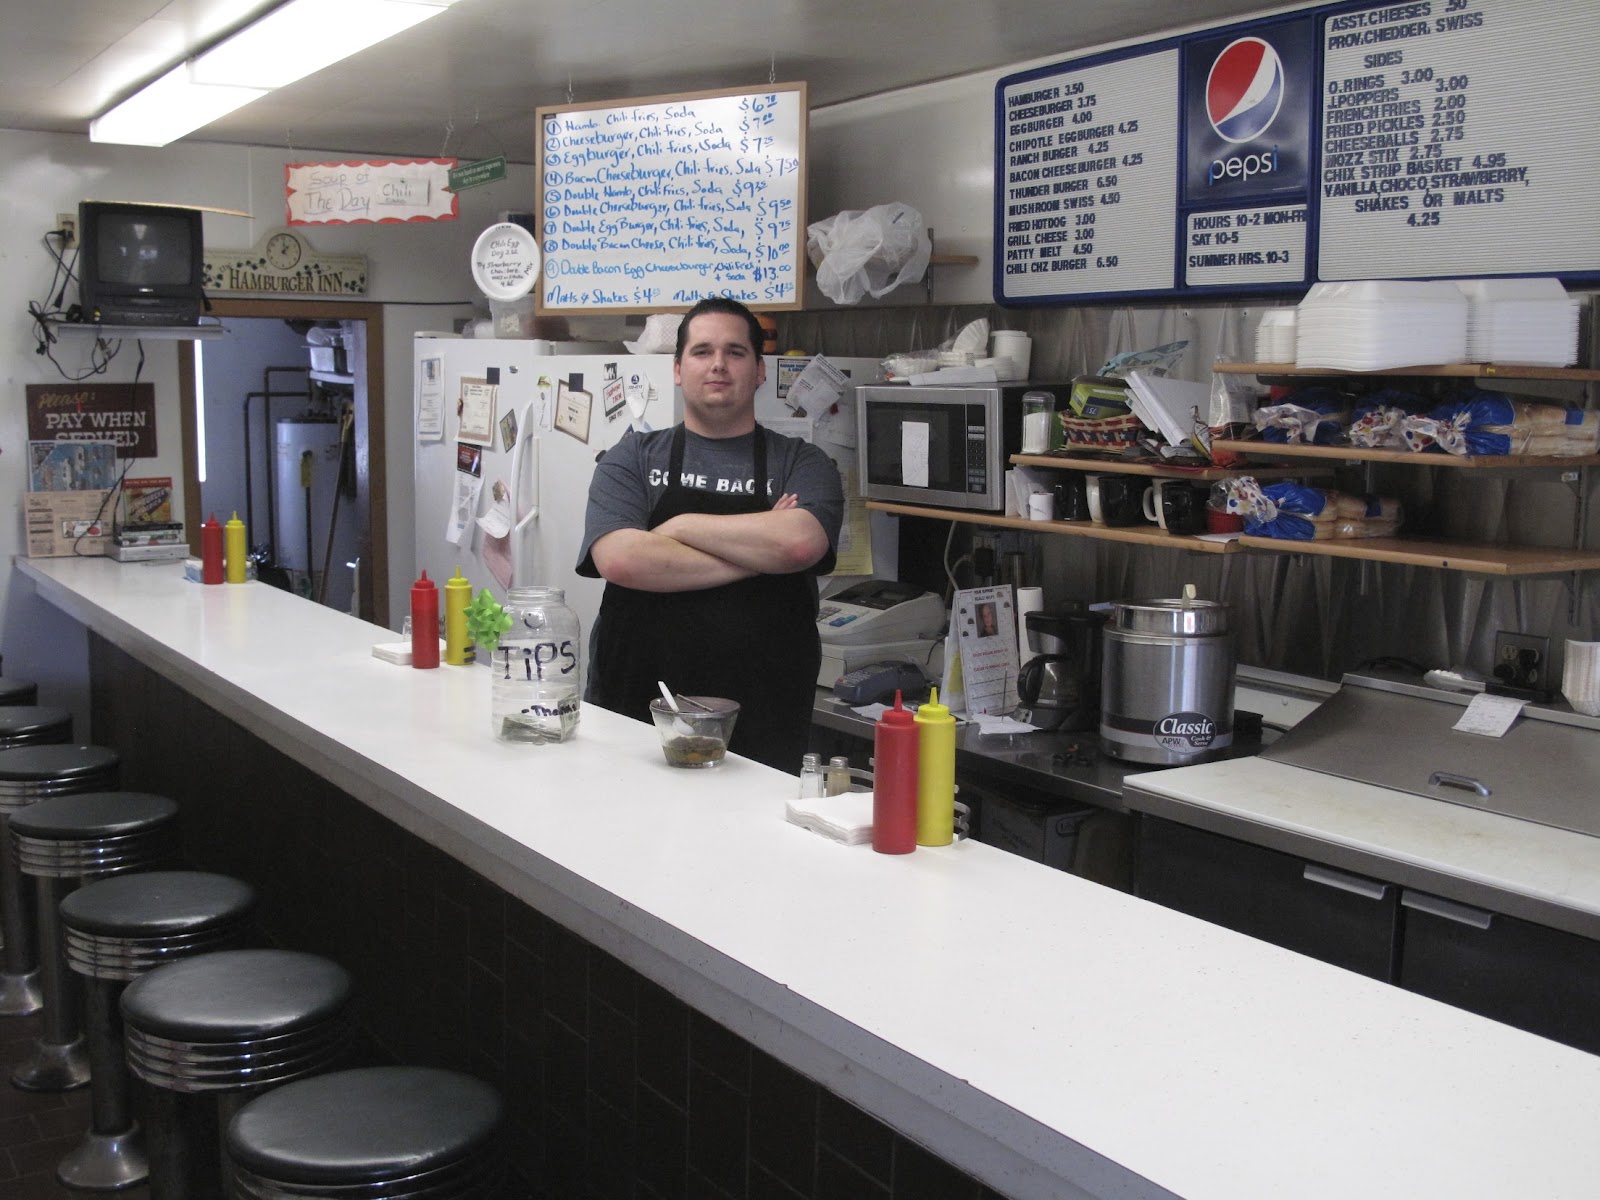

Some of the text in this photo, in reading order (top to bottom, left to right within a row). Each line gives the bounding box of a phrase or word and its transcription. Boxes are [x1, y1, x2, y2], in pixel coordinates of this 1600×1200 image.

[1436, 12, 1483, 33] SWISS
[1364, 51, 1402, 68] SIDES
[1401, 68, 1433, 84] 3.00
[1435, 75, 1468, 92] 3.00
[1008, 82, 1084, 107] HAMBURGER 3.50
[606, 111, 628, 124] Chili
[664, 106, 695, 119] Soda
[1009, 95, 1096, 122] CHEESEBURGER 3.75
[1072, 111, 1092, 124] 4.00
[1327, 94, 1466, 124] FRENCH FRIES 2.00
[639, 126, 661, 138] Chili
[695, 121, 723, 136] Soda
[1326, 110, 1466, 139] FRIED PICKLES 2.50
[1010, 136, 1052, 152] CHIPOTLE
[1118, 120, 1139, 134] 4.25
[1325, 126, 1464, 153] CHEESEBALLS 2.75
[637, 140, 662, 156] Chili
[699, 137, 732, 151] Soda
[1010, 141, 1109, 166] RANCH BURGER 4.25
[1325, 144, 1442, 168] MOZZ STIX 2.75
[565, 171, 597, 184] Bacon
[675, 160, 700, 176] Chili
[736, 158, 761, 174] Soda
[1010, 169, 1040, 183] BACON
[1122, 153, 1143, 167] 4.25
[1209, 144, 1278, 186] pepsi
[1324, 153, 1506, 183] CHIX STRIP BASKET 4.95
[310, 168, 370, 187] Soup of
[1010, 175, 1118, 199] THUNDER BURGER 6.50
[565, 188, 599, 200] Double
[638, 182, 661, 197] Chili
[692, 179, 723, 194] Soda
[305, 183, 412, 216] The Day Chili
[564, 204, 598, 216] Double
[674, 198, 695, 211] Chili
[725, 197, 751, 212] Soda
[1009, 192, 1120, 216] MUSHROOM SWISS 4.50
[1355, 188, 1504, 212] SHAKES OR MALTS
[563, 220, 595, 234] Double
[660, 217, 683, 231] Chili
[1008, 219, 1030, 232] FRIED
[1075, 213, 1095, 226] 3.00
[1194, 215, 1230, 230] HOURS
[1236, 214, 1260, 227] 10-2
[1407, 212, 1440, 227] 4.25
[562, 238, 597, 251] Double
[669, 235, 693, 249] Chili
[1008, 228, 1094, 247] GRILL CHEESE 3.00
[1192, 232, 1239, 246] SAT 10-5
[1007, 243, 1093, 261] PATTY MELT 4.50
[1189, 254, 1236, 267] SUMMER
[1266, 250, 1289, 263] 10-3
[624, 263, 645, 279] Egg
[1007, 256, 1118, 275] CHILI CHZ BURGER 6.50
[230, 269, 343, 292] HAMBURGER INN
[592, 289, 628, 304] Shakes
[46, 411, 146, 429] PAY WHEN
[1160, 718, 1212, 735] Classic
